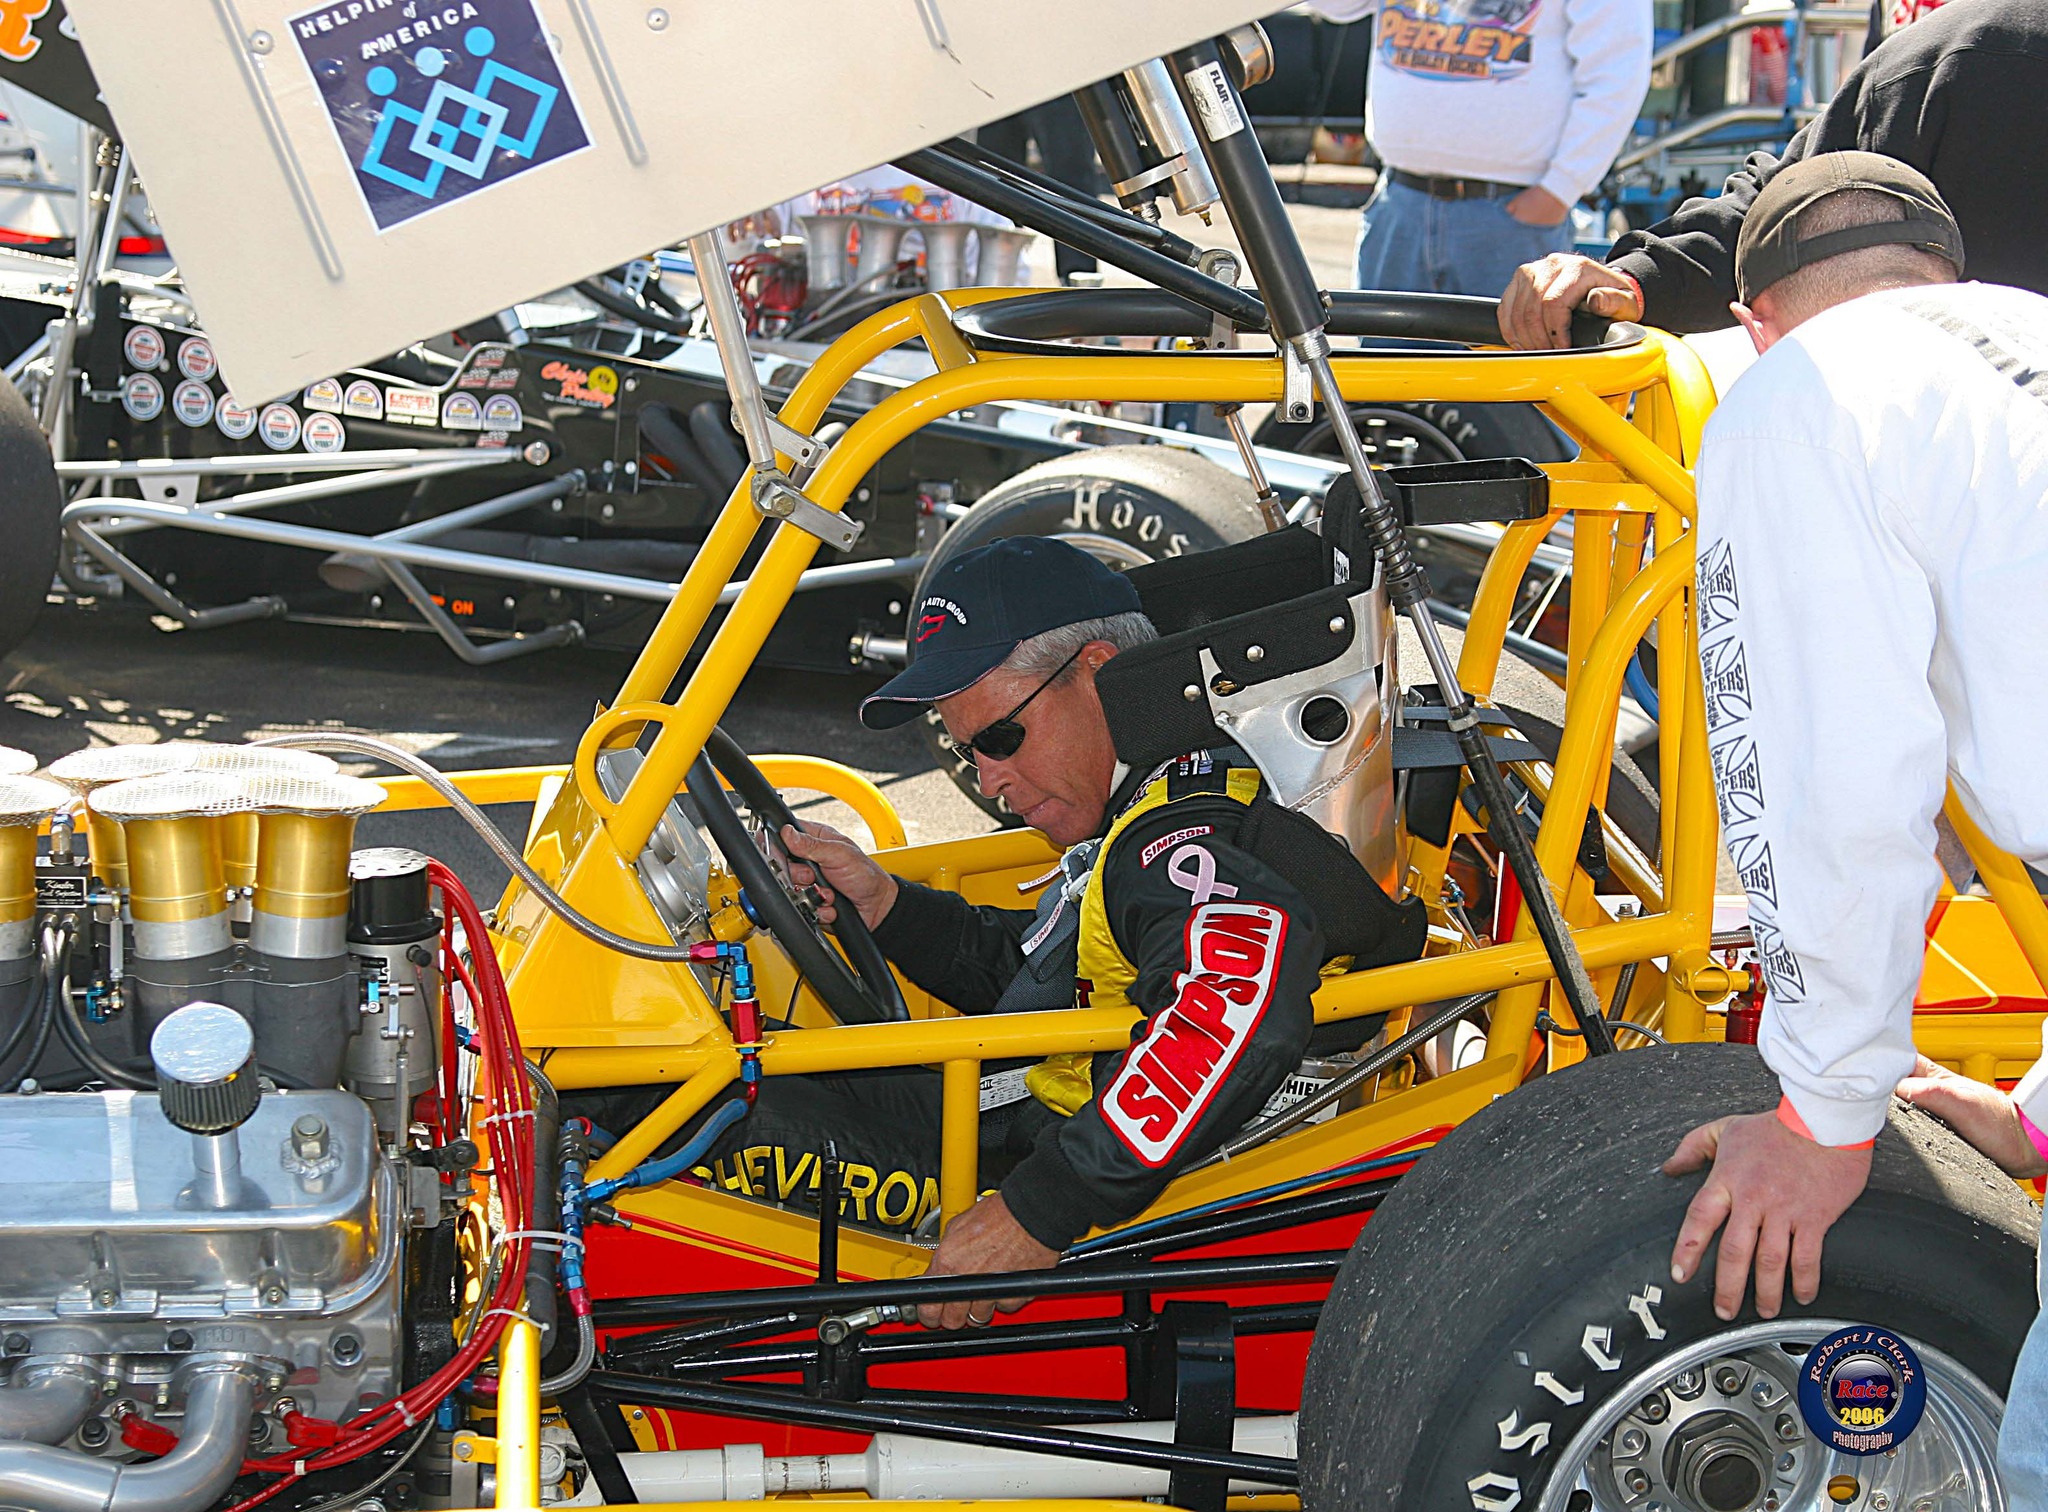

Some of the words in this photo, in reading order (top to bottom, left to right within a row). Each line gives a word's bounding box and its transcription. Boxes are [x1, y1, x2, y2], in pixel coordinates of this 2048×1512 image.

[361, 2, 478, 60] AMERICA
[1377, 9, 1526, 62] PERLEY
[452, 600, 475, 616] ON
[926, 597, 946, 608] AUTO
[945, 601, 967, 625] GROUP
[1144, 827, 1207, 862] SIMPSON
[1117, 912, 1273, 1143] SIMPSON
